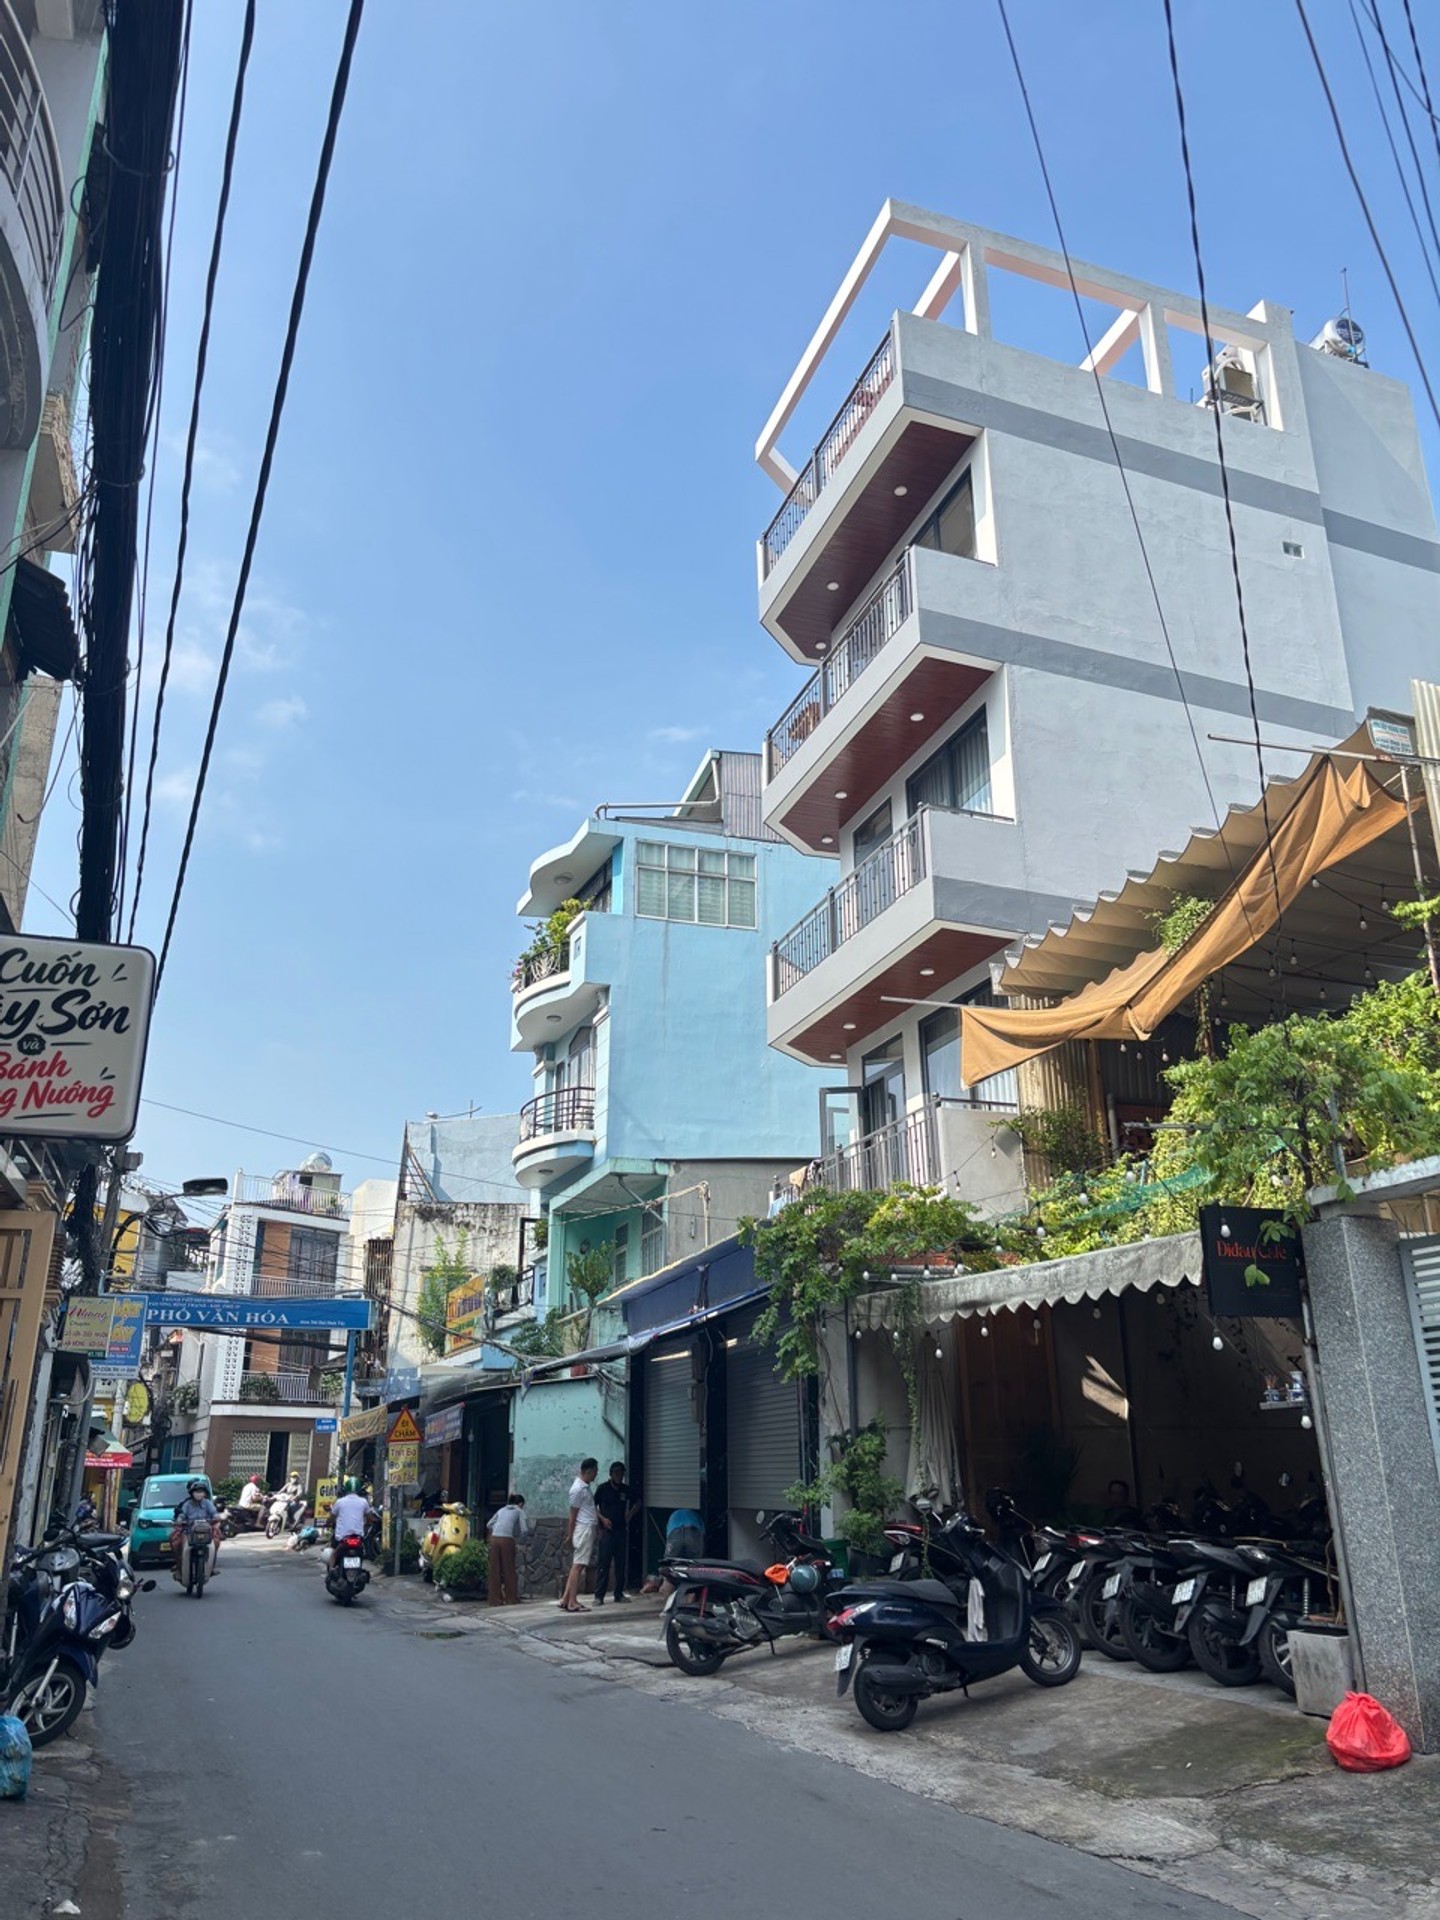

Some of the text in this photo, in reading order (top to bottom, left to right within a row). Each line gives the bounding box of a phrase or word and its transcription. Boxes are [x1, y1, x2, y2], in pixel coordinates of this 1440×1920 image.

[0, 948, 100, 986] Cuốn
[0, 988, 130, 1040] y Sơn
[22, 1037, 40, 1049] và
[21, 1079, 116, 1118] Nướng
[147, 1307, 191, 1321] PHỐ
[196, 1308, 239, 1322] VĂN
[246, 1309, 289, 1324] HÓA
